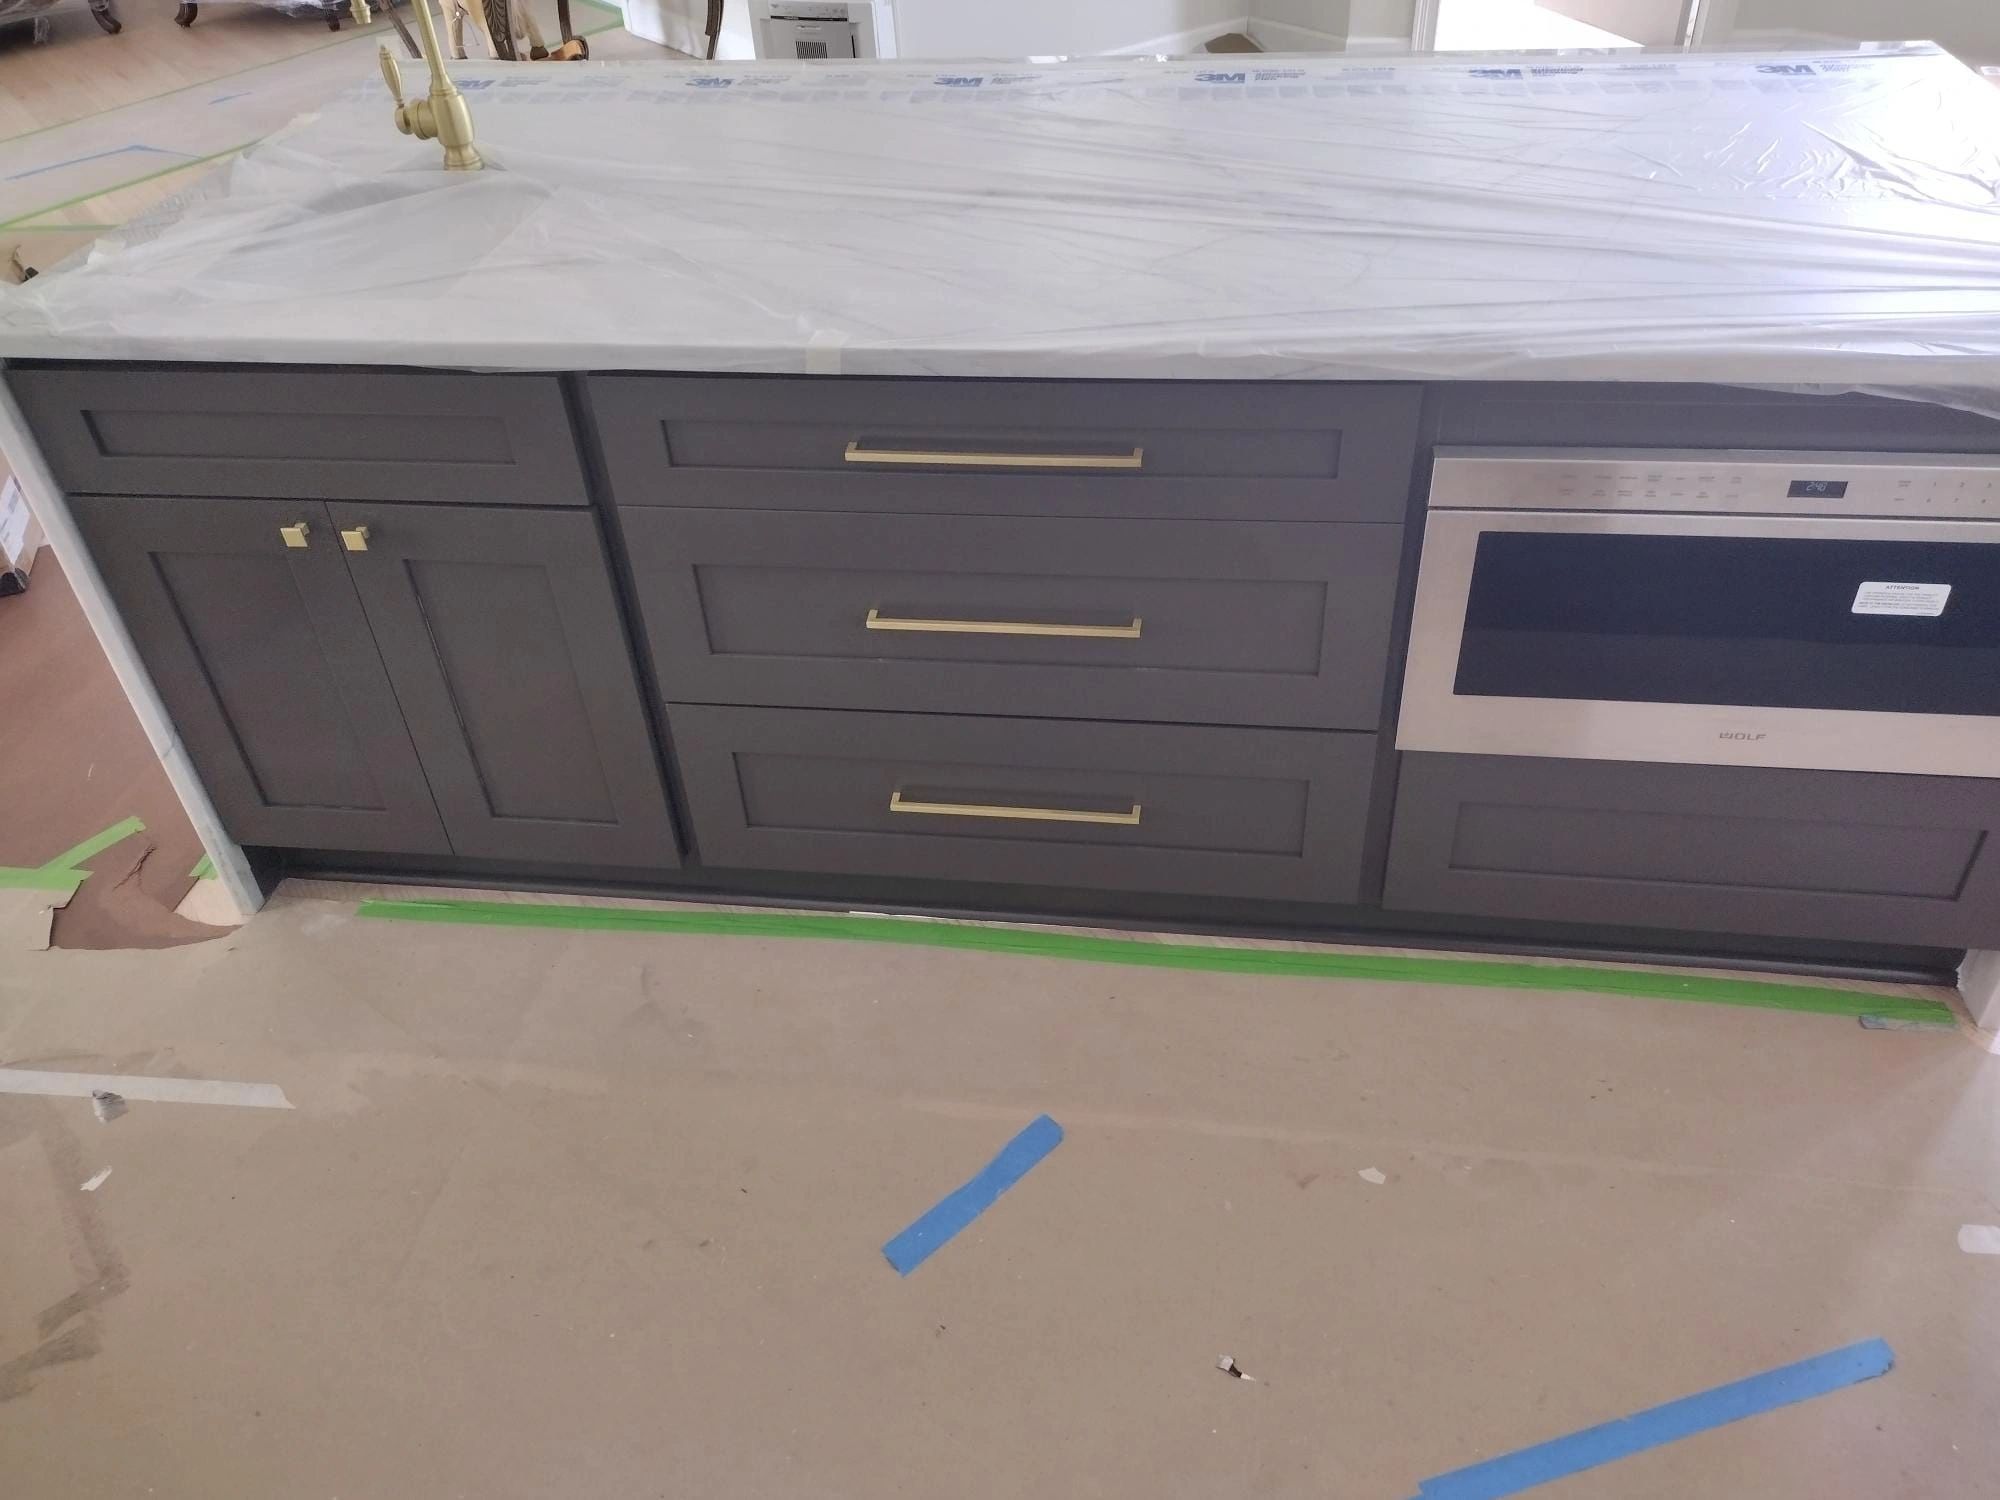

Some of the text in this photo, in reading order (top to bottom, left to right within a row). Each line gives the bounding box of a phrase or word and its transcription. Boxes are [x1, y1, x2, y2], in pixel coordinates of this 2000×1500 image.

[1756, 64, 1817, 76] 3M
[934, 77, 984, 88] 3M
[1194, 72, 1246, 84] 3M
[1719, 732, 1767, 741] WOLF
